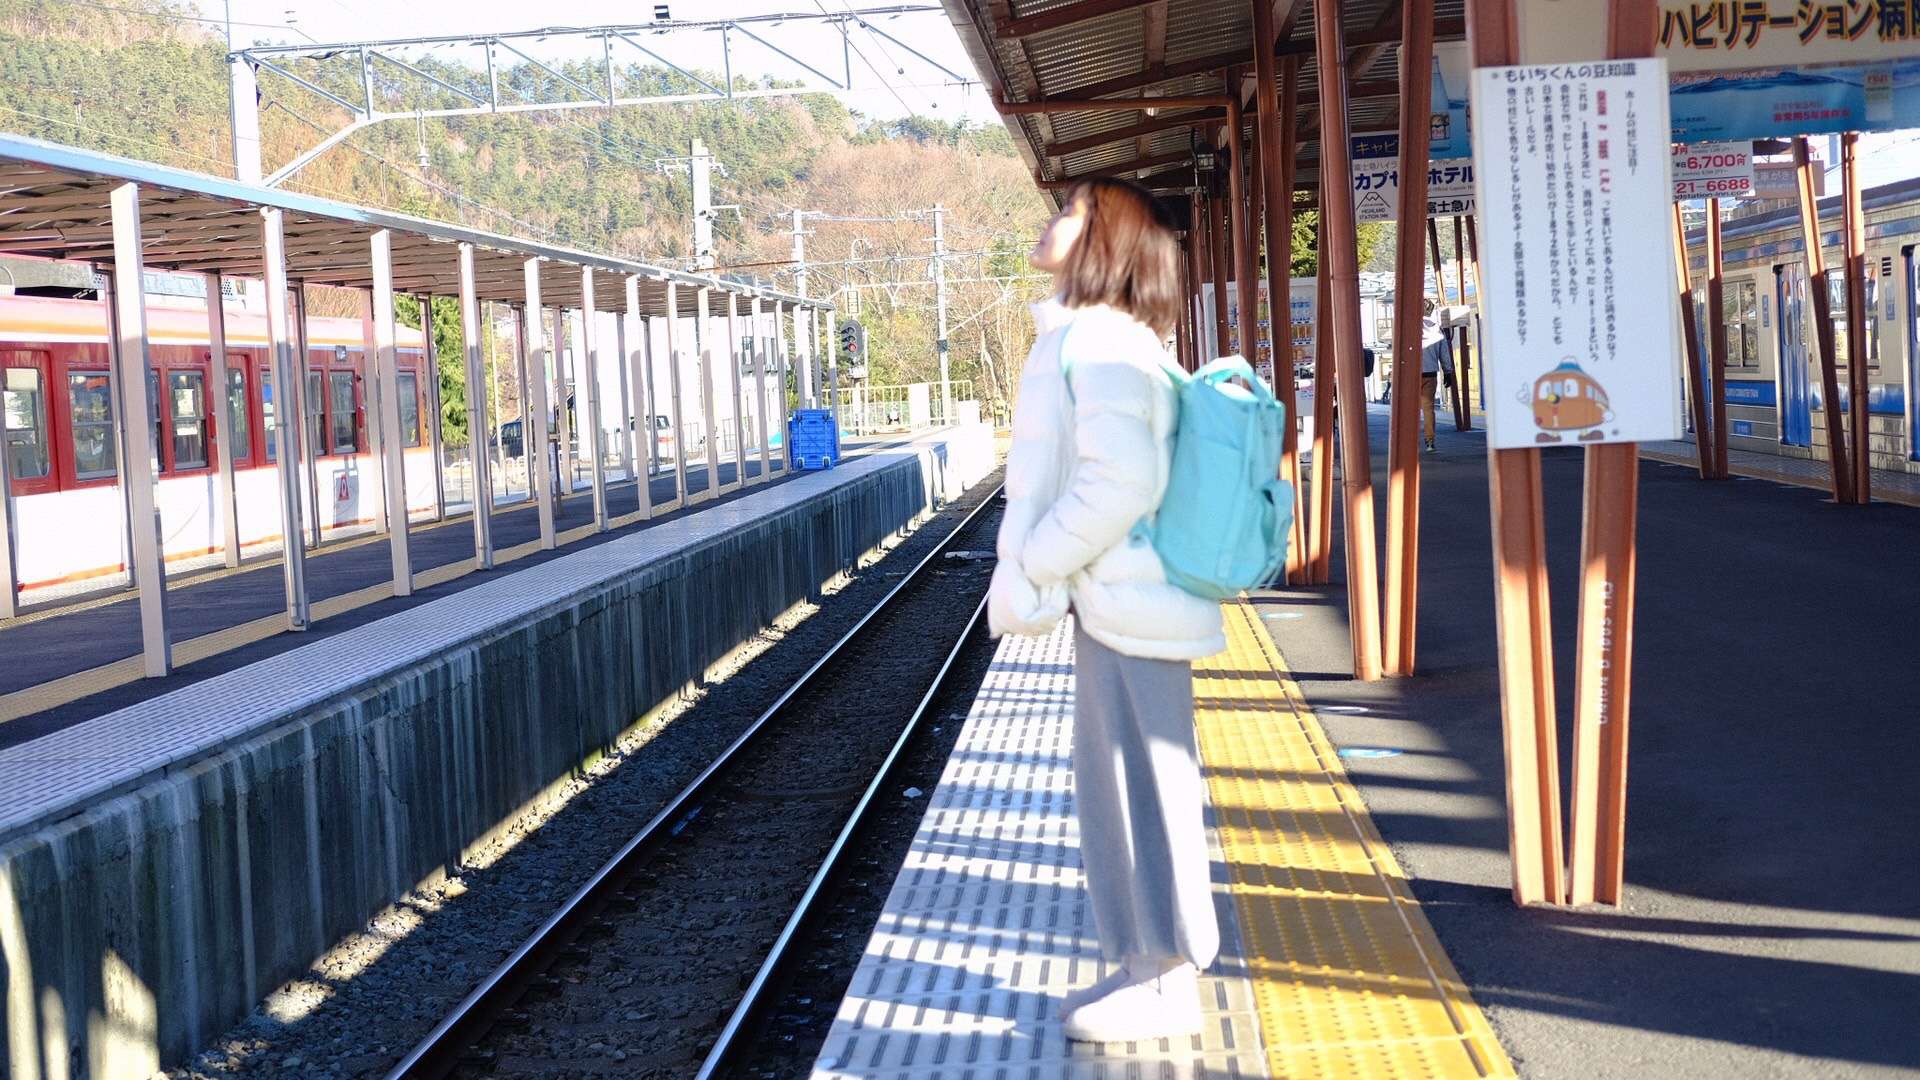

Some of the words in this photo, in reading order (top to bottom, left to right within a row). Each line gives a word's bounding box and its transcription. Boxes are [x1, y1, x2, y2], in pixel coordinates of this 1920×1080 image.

[1505, 63, 1636, 82] もいちくんの豆知識
